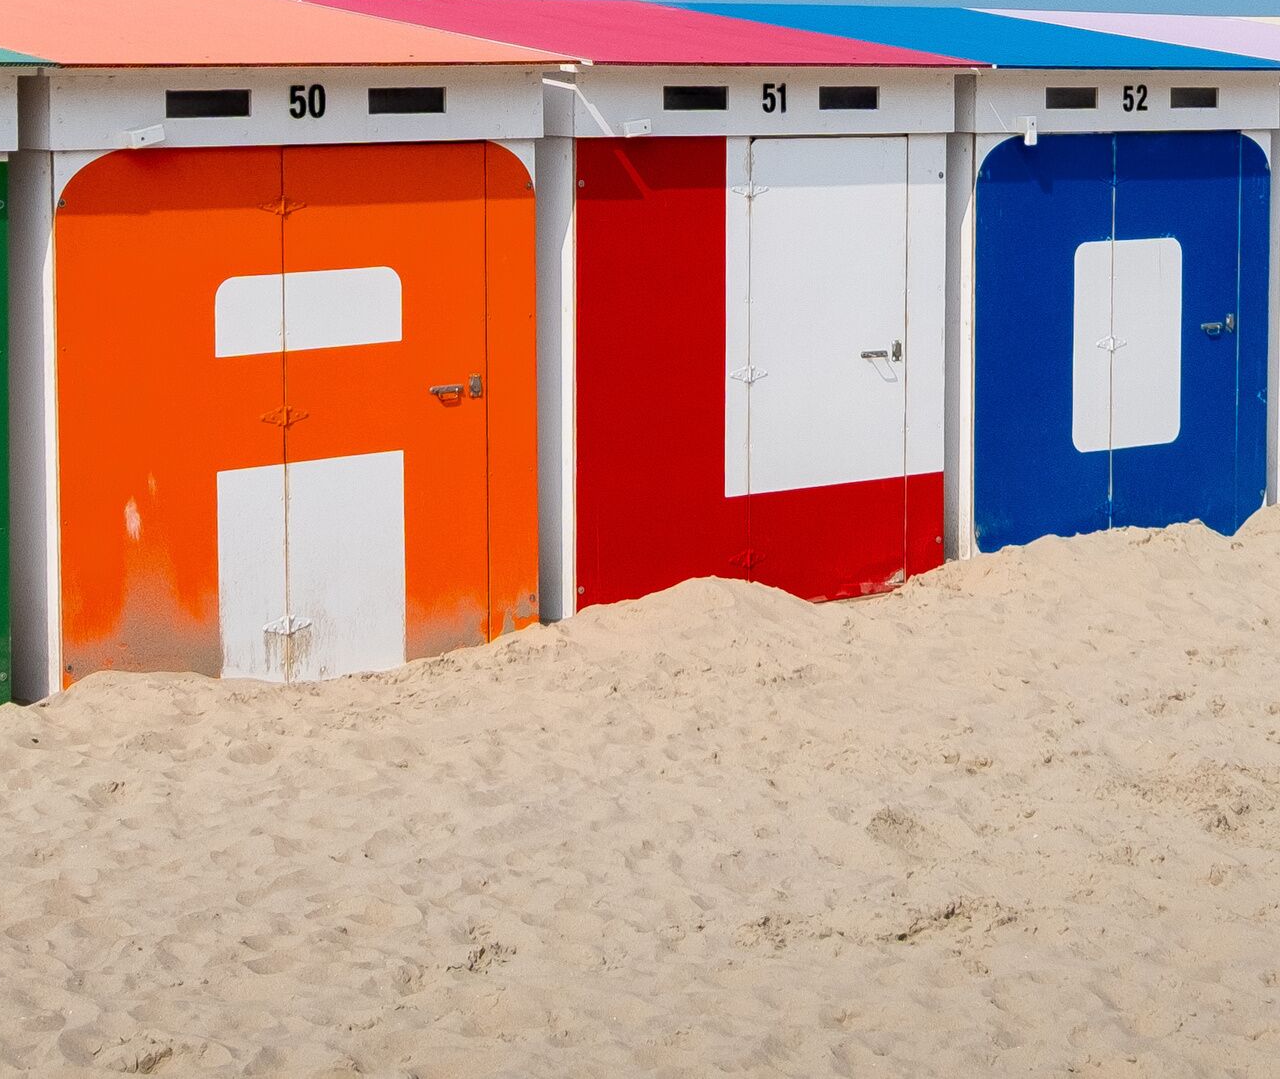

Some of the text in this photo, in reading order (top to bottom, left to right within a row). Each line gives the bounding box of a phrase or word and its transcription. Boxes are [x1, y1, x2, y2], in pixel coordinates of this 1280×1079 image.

[289, 83, 327, 120] 50
[761, 82, 787, 114] 51
[1122, 83, 1148, 113] 52
